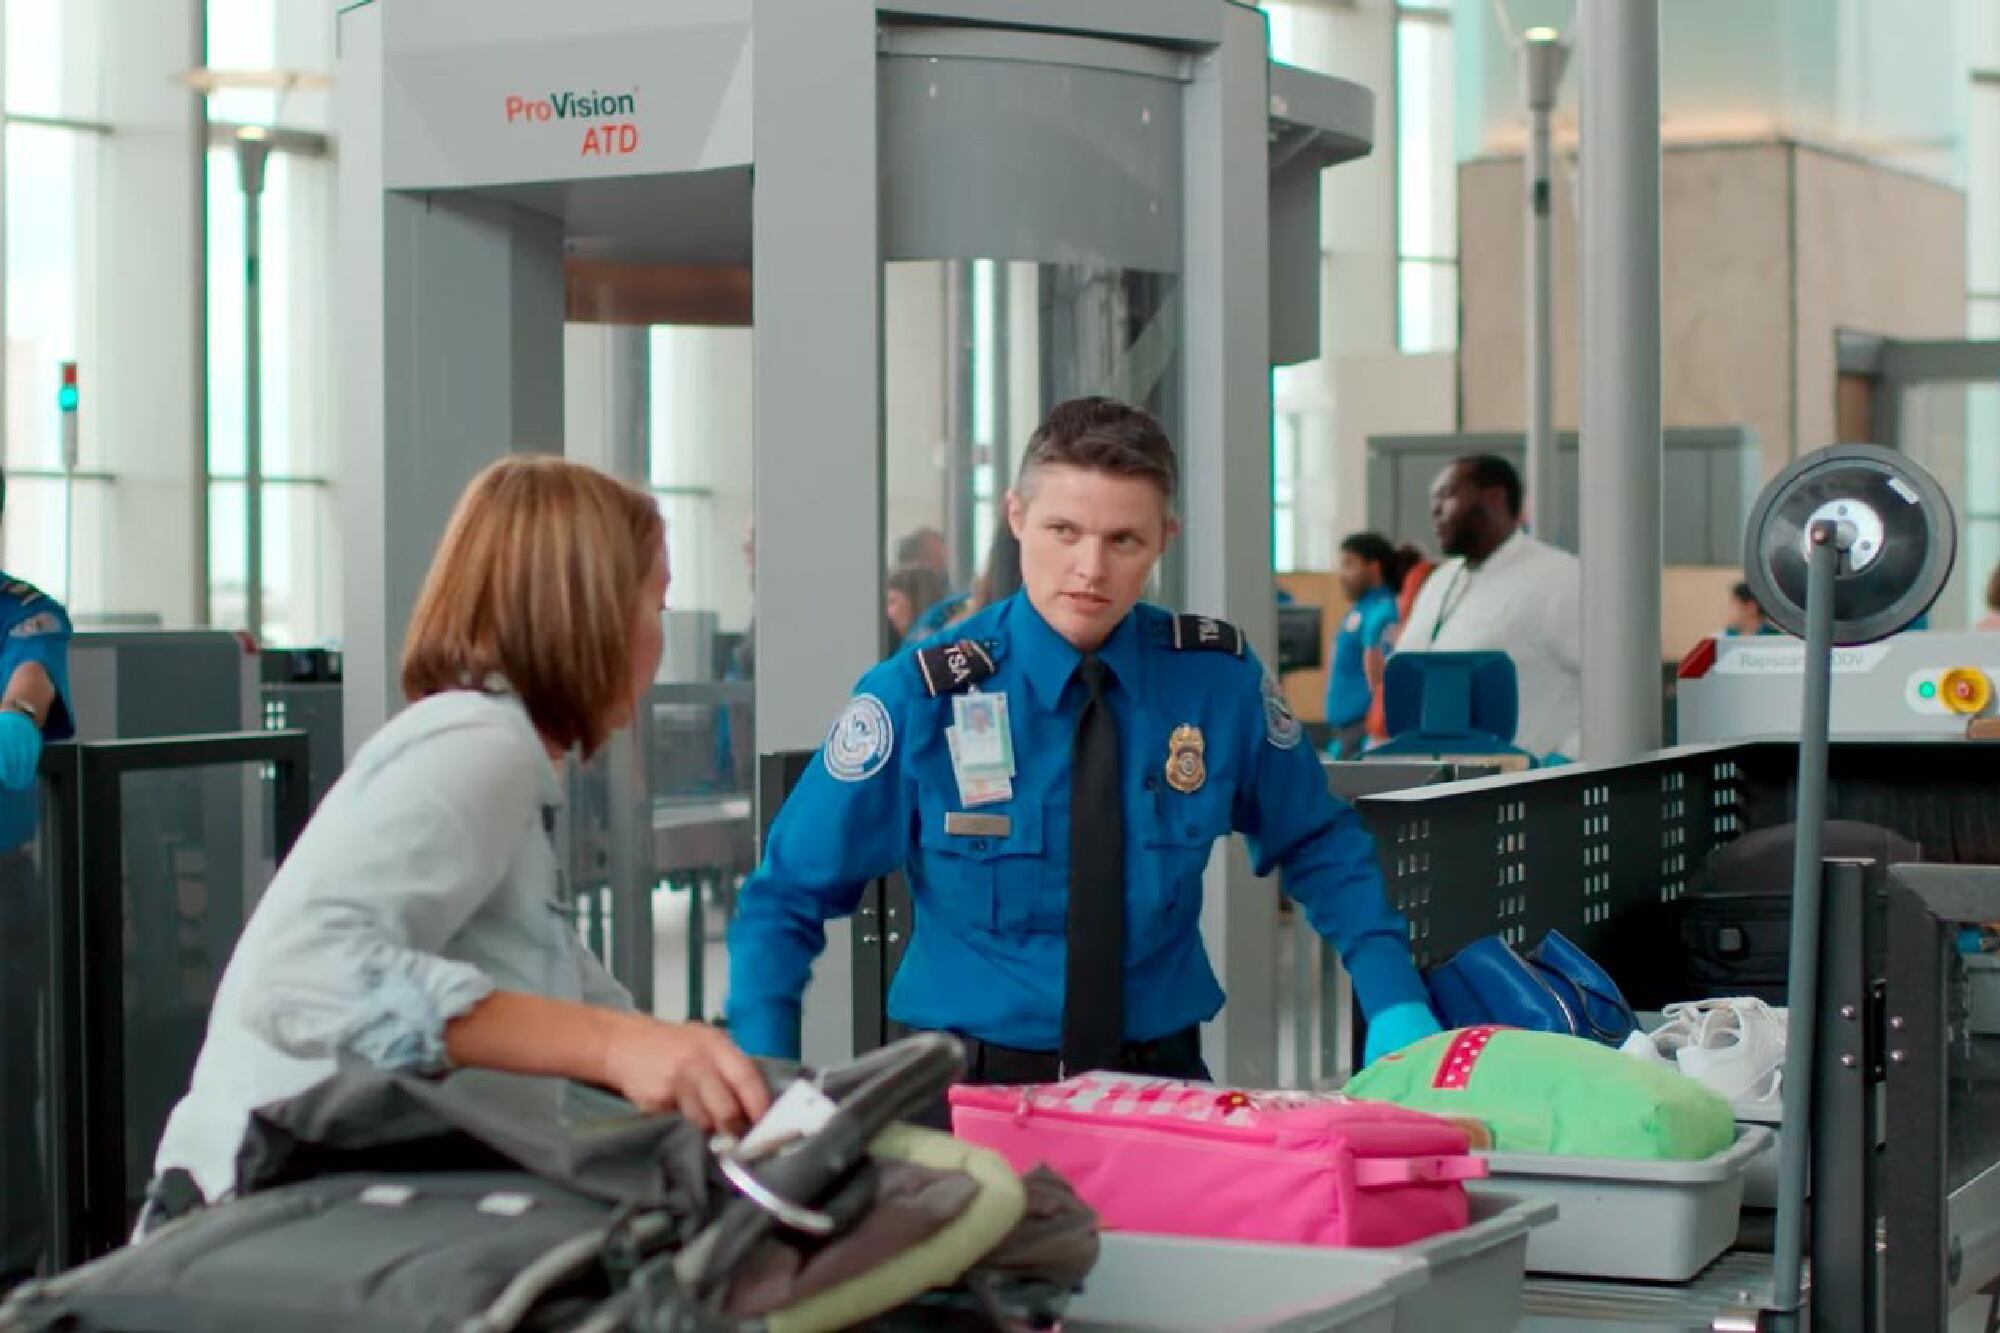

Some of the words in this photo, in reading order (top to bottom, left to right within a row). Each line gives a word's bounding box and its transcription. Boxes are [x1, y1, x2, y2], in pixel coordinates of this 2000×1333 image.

[505, 89, 636, 123] ProVision
[581, 124, 637, 156] ATD
[944, 647, 971, 684] TSA
